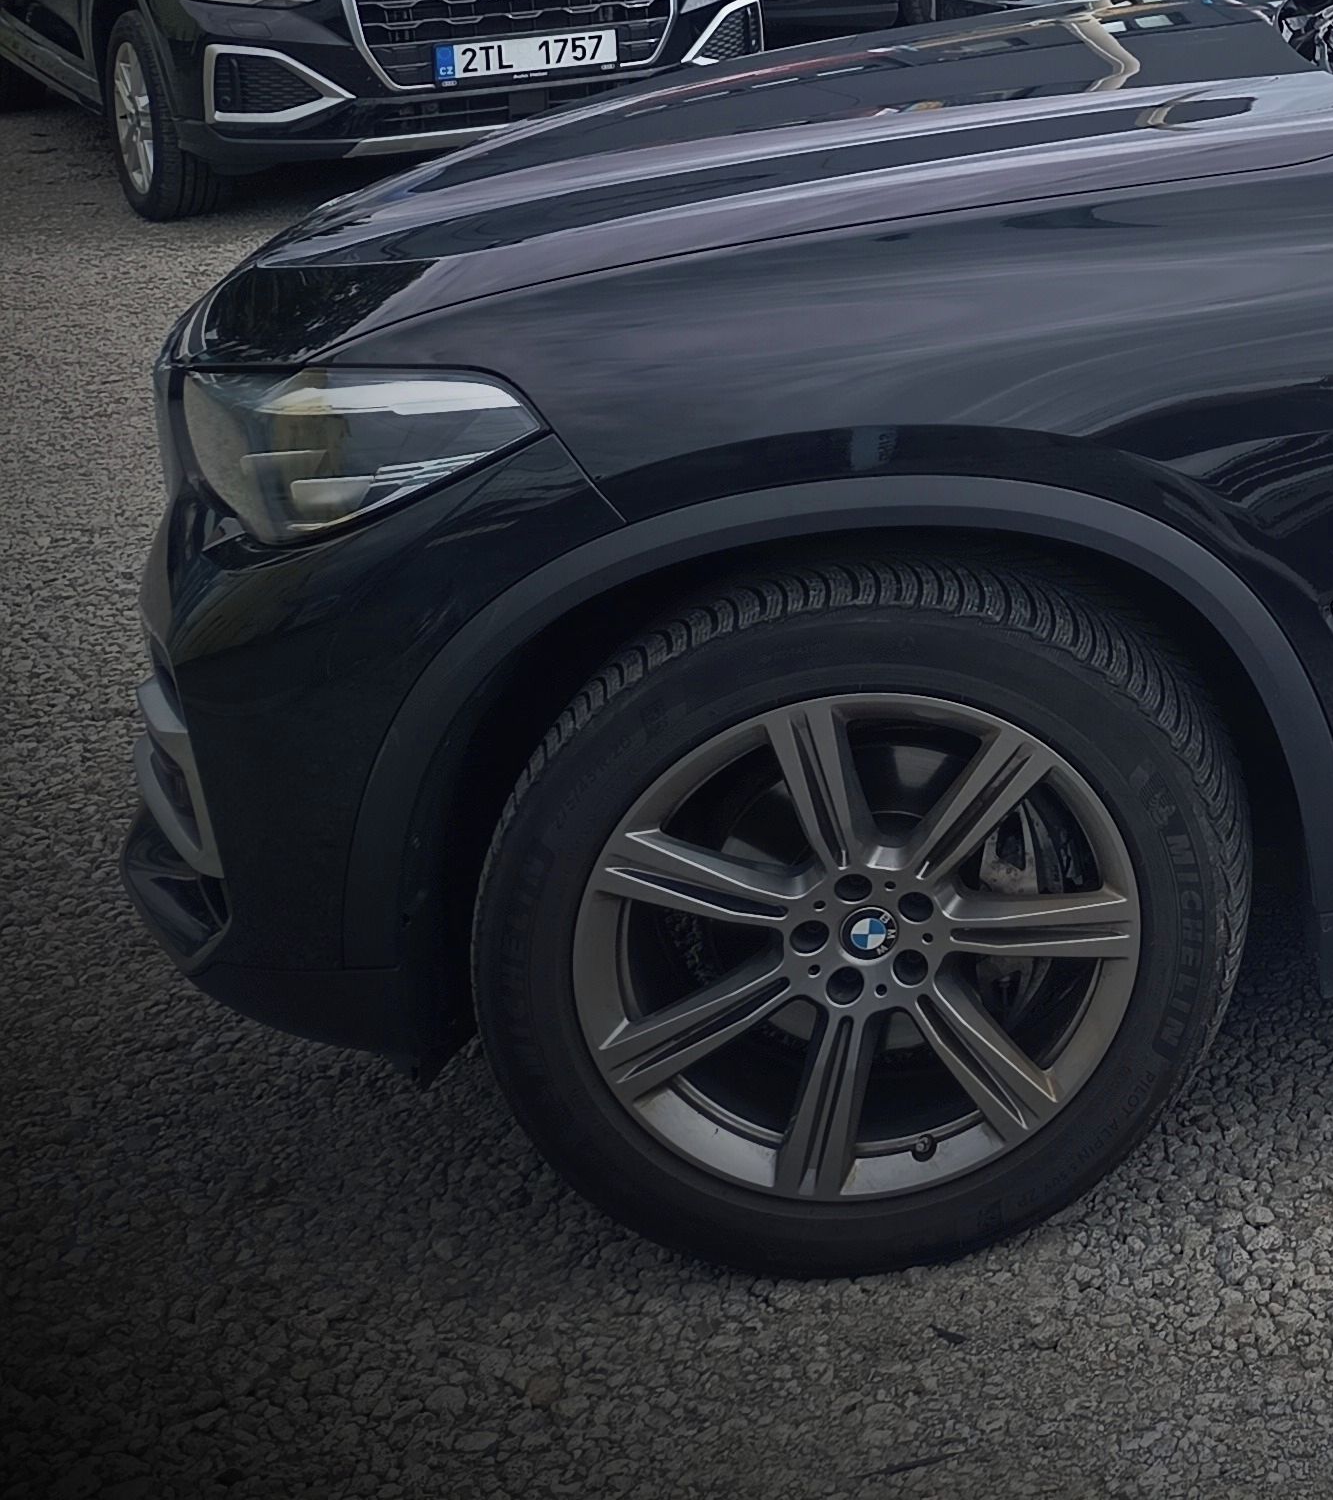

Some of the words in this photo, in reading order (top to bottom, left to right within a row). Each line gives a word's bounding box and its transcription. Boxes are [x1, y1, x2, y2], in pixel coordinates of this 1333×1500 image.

[439, 66, 454, 75] CZ
[461, 45, 513, 73] 2TL
[538, 35, 603, 65] 1757
[1159, 833, 1204, 1048] MICHELIN
[1122, 1069, 1157, 1118] PILOT
[1076, 1118, 1121, 1164] ALPIN
